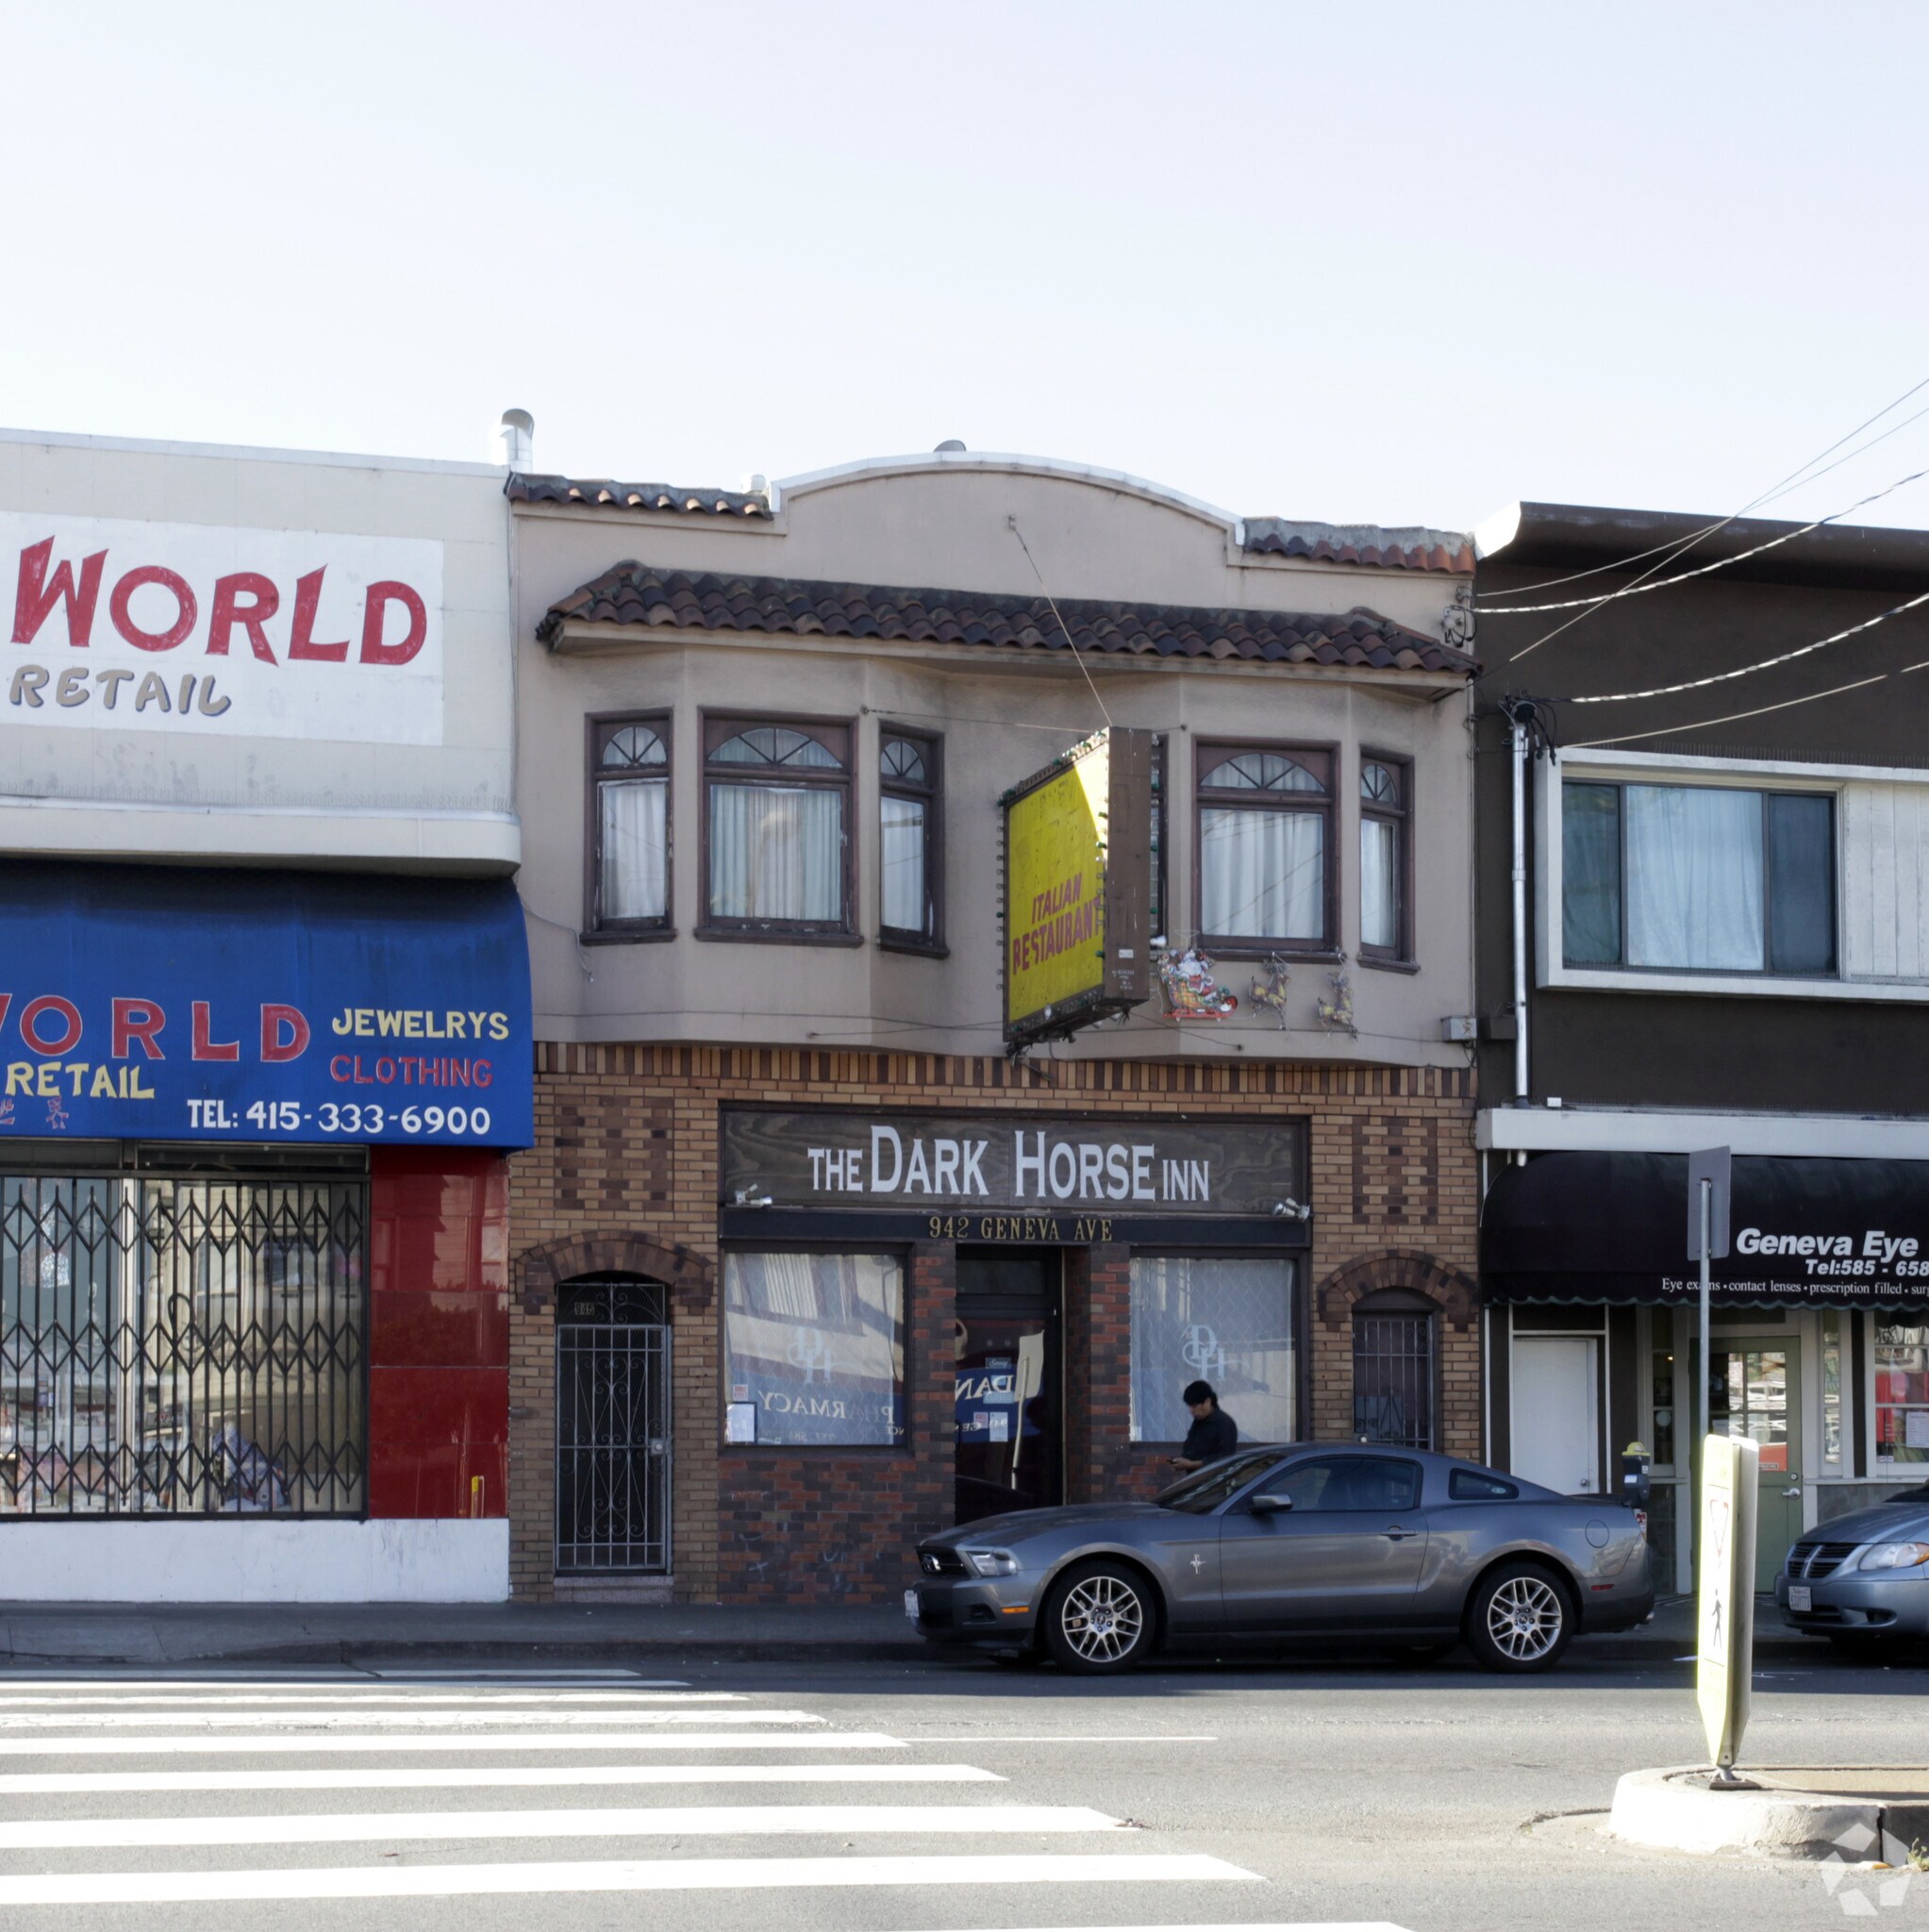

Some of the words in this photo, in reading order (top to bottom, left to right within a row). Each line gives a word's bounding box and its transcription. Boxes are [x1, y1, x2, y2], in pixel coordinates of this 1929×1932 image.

[10, 535, 427, 666] WORLD
[9, 664, 232, 717] RETAIL
[1031, 873, 1082, 924] ITALIAN
[1013, 896, 1102, 975] RESTAURANT
[0, 992, 310, 1062] ORLD
[332, 1008, 509, 1040] JEWELRYS
[5, 1061, 155, 1099] RETAIL
[330, 1055, 493, 1087] CLOTHING
[187, 1099, 239, 1128] TEL:
[246, 1101, 491, 1134] 415-333-6900
[807, 1147, 863, 1191] THE
[871, 1125, 989, 1196] DARK
[1014, 1130, 1156, 1203] HORSE
[1162, 1159, 1209, 1201] INN
[928, 1216, 969, 1239] 942
[981, 1217, 1060, 1241] GENEVA
[1074, 1220, 1112, 1241] AVE
[1737, 1228, 1853, 1257] Geneva
[1863, 1230, 1919, 1263] Eye
[1805, 1259, 1876, 1275] Tel:585
[1662, 1277, 1683, 1293] Eye
[1687, 1280, 1721, 1291] exms
[1728, 1281, 1767, 1291] contact
[1771, 1279, 1802, 1292] lenses
[1809, 1281, 1871, 1296] prescription
[1874, 1282, 1903, 1295] filled
